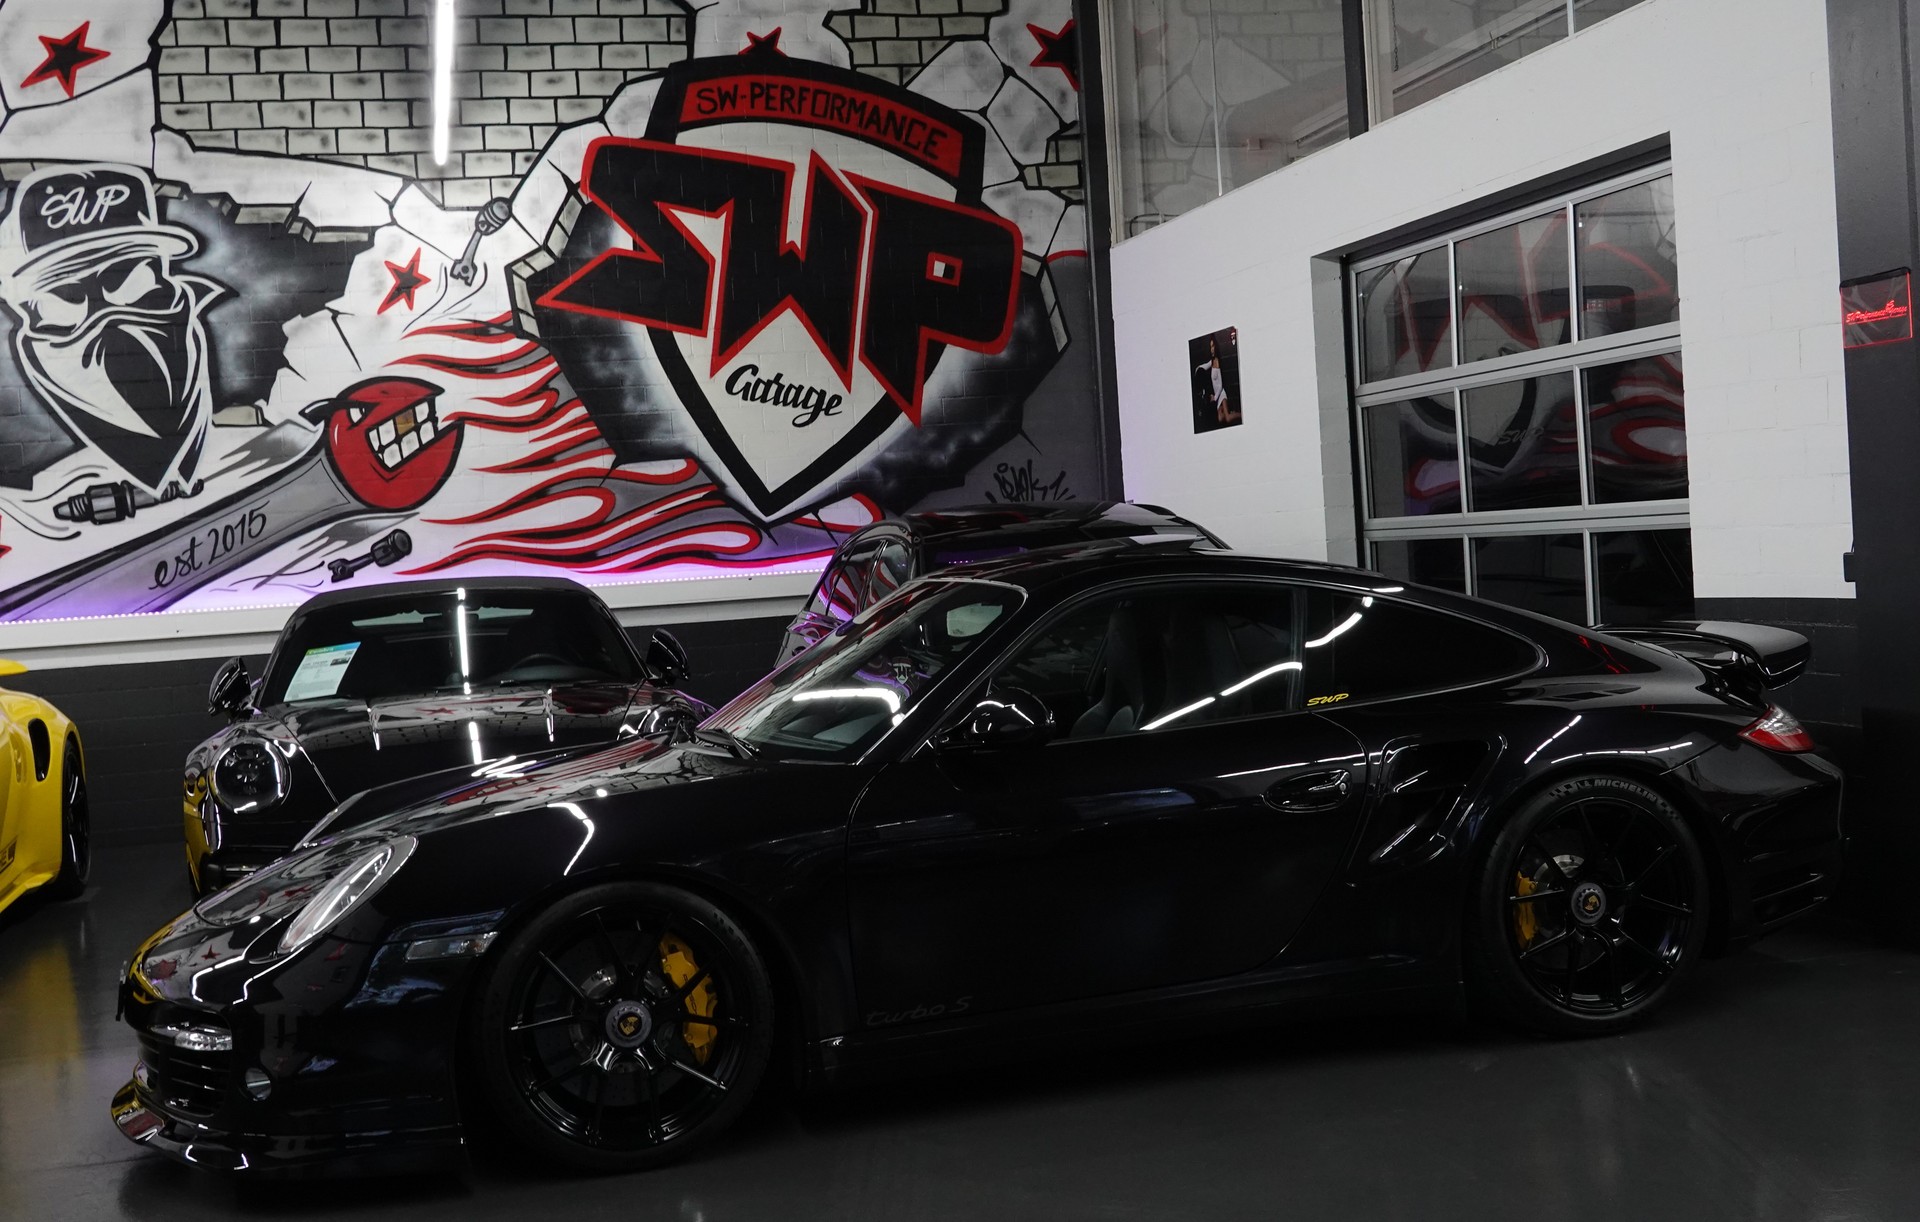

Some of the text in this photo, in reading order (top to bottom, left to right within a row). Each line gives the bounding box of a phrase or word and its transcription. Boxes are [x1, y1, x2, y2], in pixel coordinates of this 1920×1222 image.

[696, 82, 948, 160] SW-PERFORMANCE
[537, 136, 1023, 428] SWP
[724, 363, 843, 427] Garage
[148, 500, 270, 590] est 2015
[1306, 692, 1350, 706] SWP
[1594, 778, 1657, 803] MICHELIN
[866, 996, 974, 1026] turbo S
